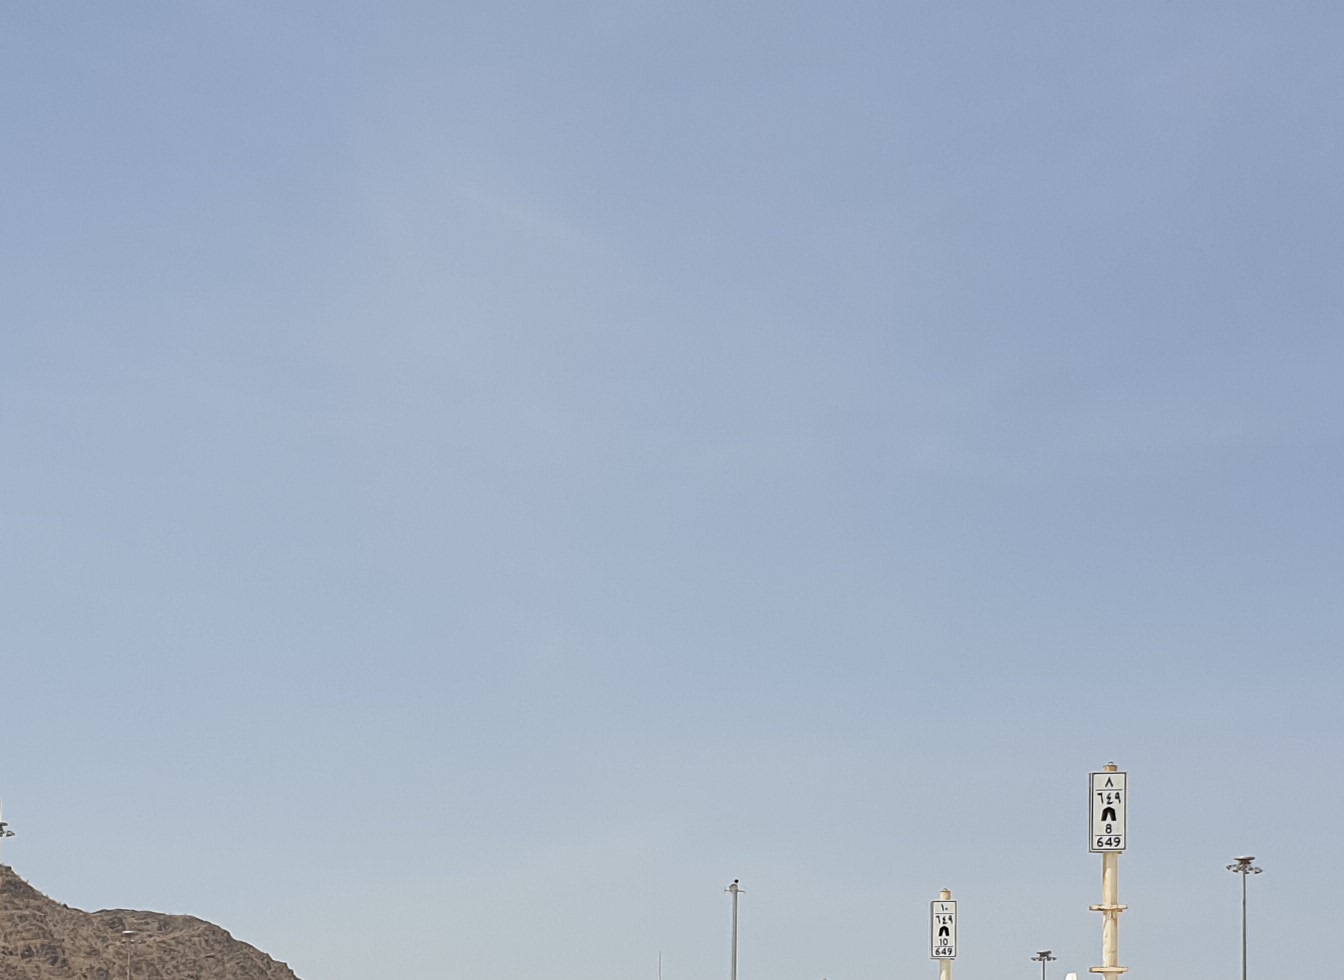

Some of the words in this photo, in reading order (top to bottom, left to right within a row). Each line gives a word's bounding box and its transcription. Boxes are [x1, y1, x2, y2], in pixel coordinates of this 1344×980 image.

[1104, 776, 1114, 788] ٨
[1096, 791, 1121, 805] ٦٤٩
[1105, 823, 1113, 834] 8
[1096, 837, 1121, 848] 649
[936, 915, 953, 925] ٦٤٩
[939, 938, 949, 946] 10
[935, 947, 953, 956] 649
